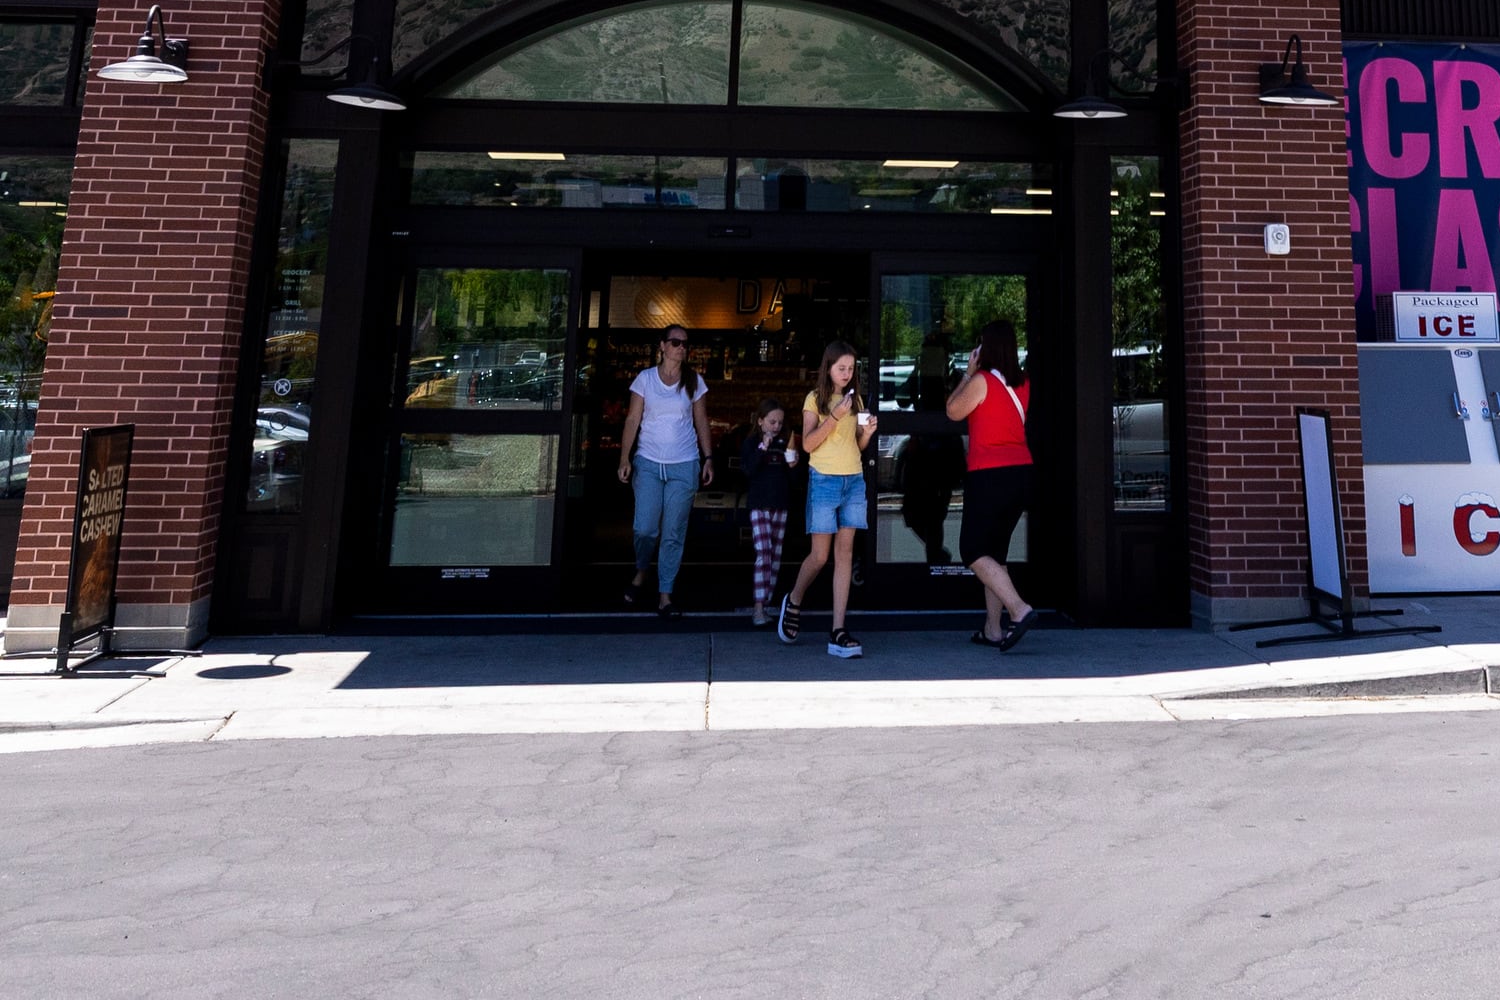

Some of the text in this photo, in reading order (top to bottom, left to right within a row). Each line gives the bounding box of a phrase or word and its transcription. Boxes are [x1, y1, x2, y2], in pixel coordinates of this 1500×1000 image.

[1412, 296, 1479, 308] Packaged
[1418, 313, 1476, 337] ICE
[82, 488, 124, 518] CARAMEL
[80, 512, 122, 544] CASHEW
